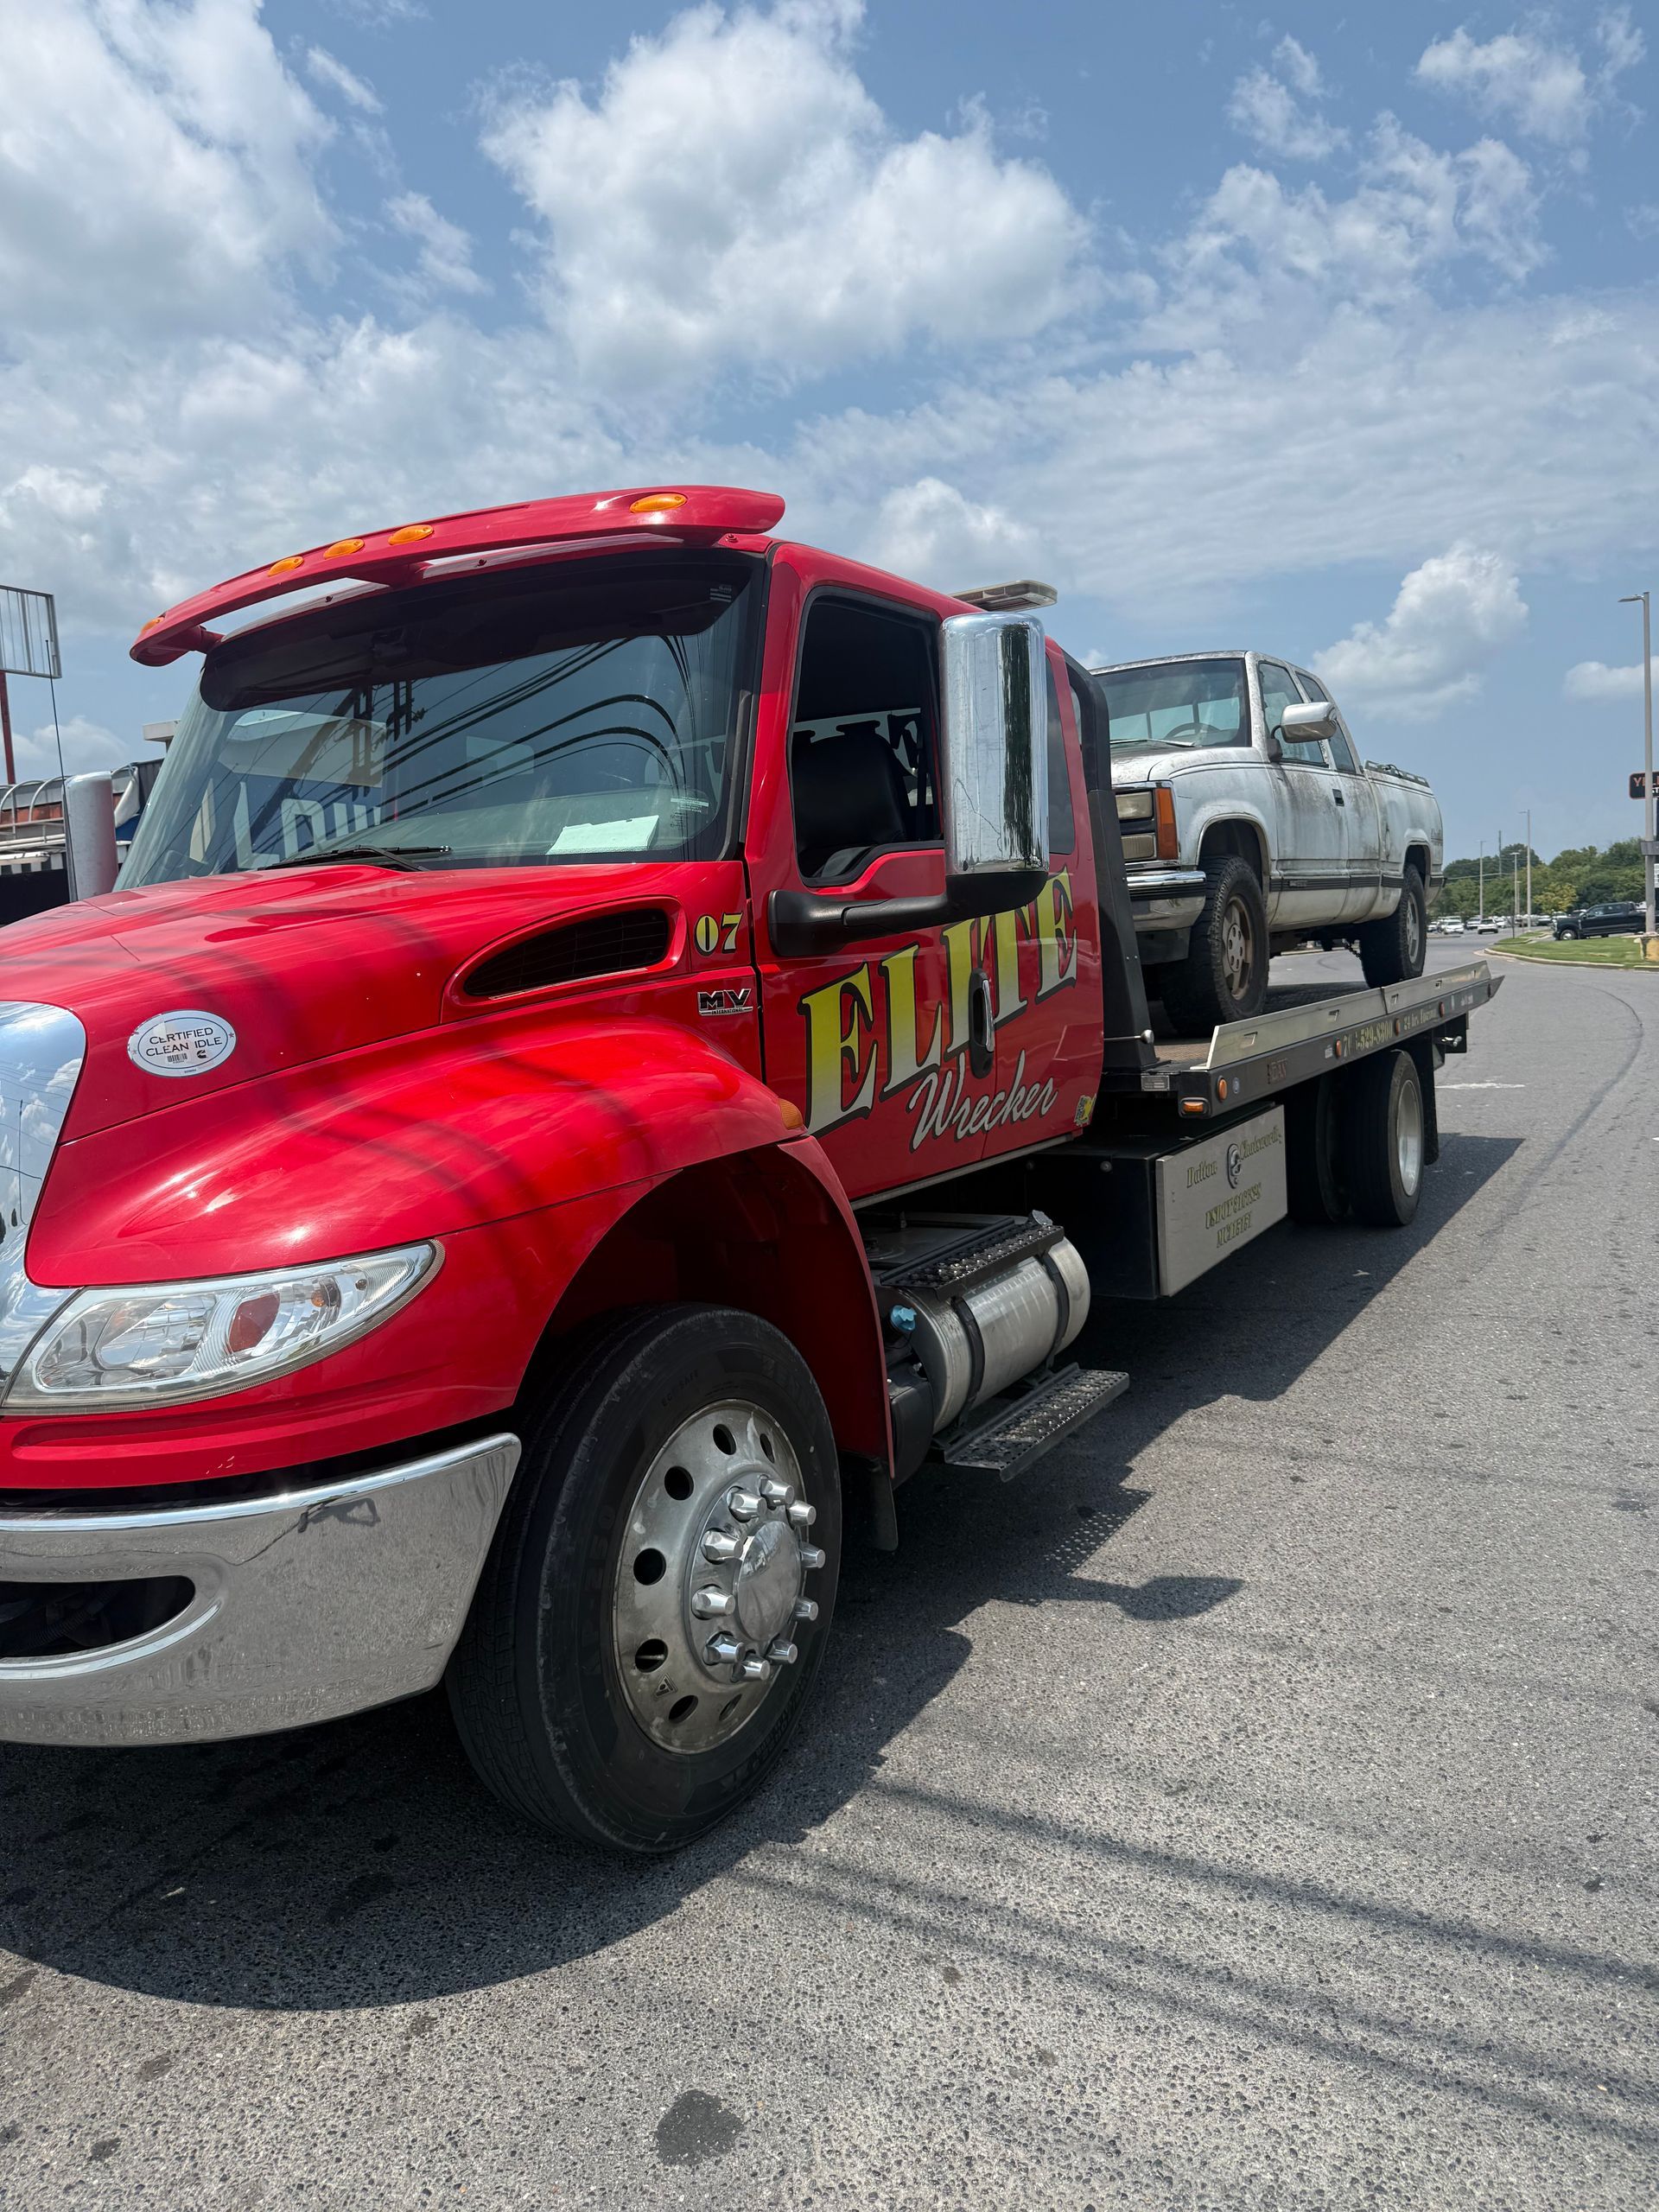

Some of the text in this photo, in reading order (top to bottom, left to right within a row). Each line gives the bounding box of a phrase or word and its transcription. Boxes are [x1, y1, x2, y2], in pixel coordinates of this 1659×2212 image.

[694, 912, 743, 957] 07
[697, 988, 752, 1010] MV
[797, 866, 1077, 1138] ELITE
[145, 1036, 223, 1058] CLEAN IDLE
[149, 1027, 214, 1045] CERTIFIED
[906, 1049, 1058, 1152] Wrecker
